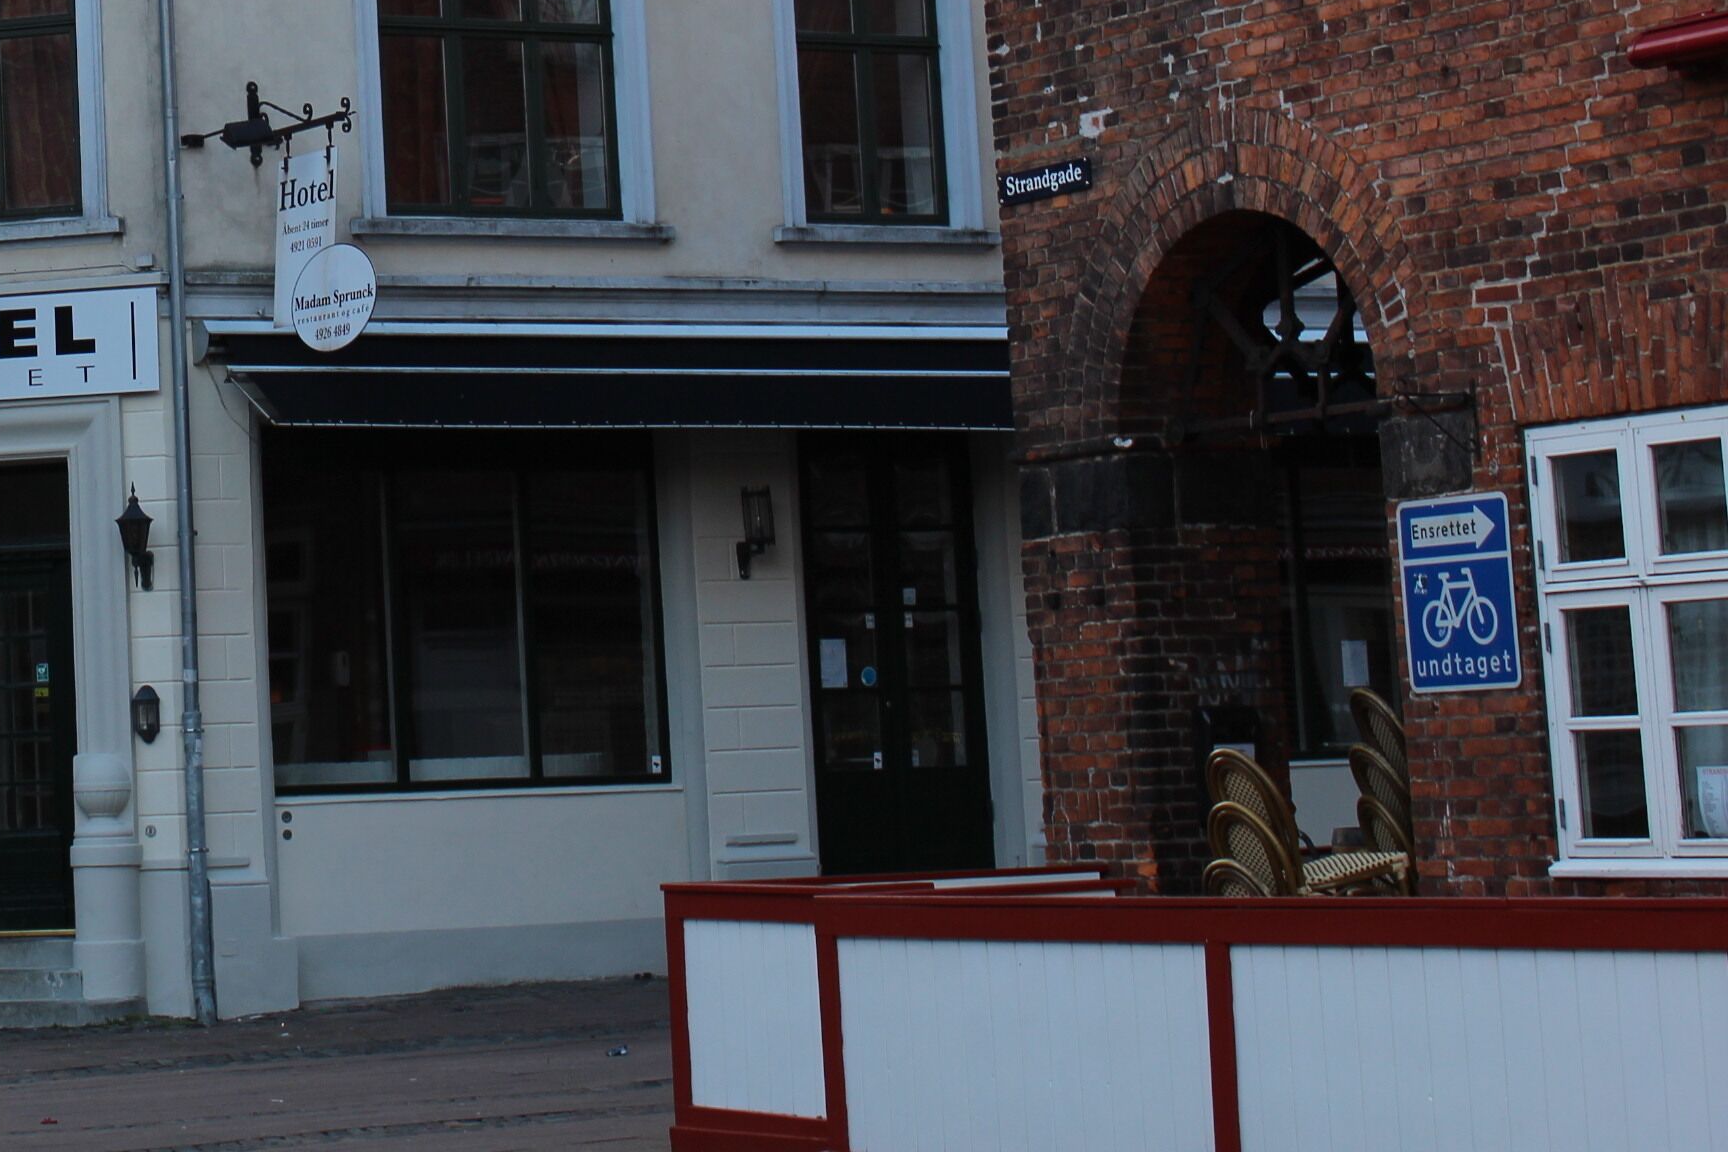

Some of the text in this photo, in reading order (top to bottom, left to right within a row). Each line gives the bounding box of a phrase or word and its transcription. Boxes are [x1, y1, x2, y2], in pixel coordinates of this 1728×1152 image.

[1005, 163, 1082, 196] Strandgade
[279, 169, 335, 212] Hotel
[283, 218, 329, 235] Åbent 24 timer
[290, 239, 305, 253] 4921
[295, 283, 374, 312] Madam Sprunck
[297, 311, 339, 325] restaurant
[341, 310, 350, 319] og
[315, 322, 351, 341] 4926 4849
[1411, 519, 1477, 540] Ensrettet
[1417, 649, 1512, 678] undtaget
